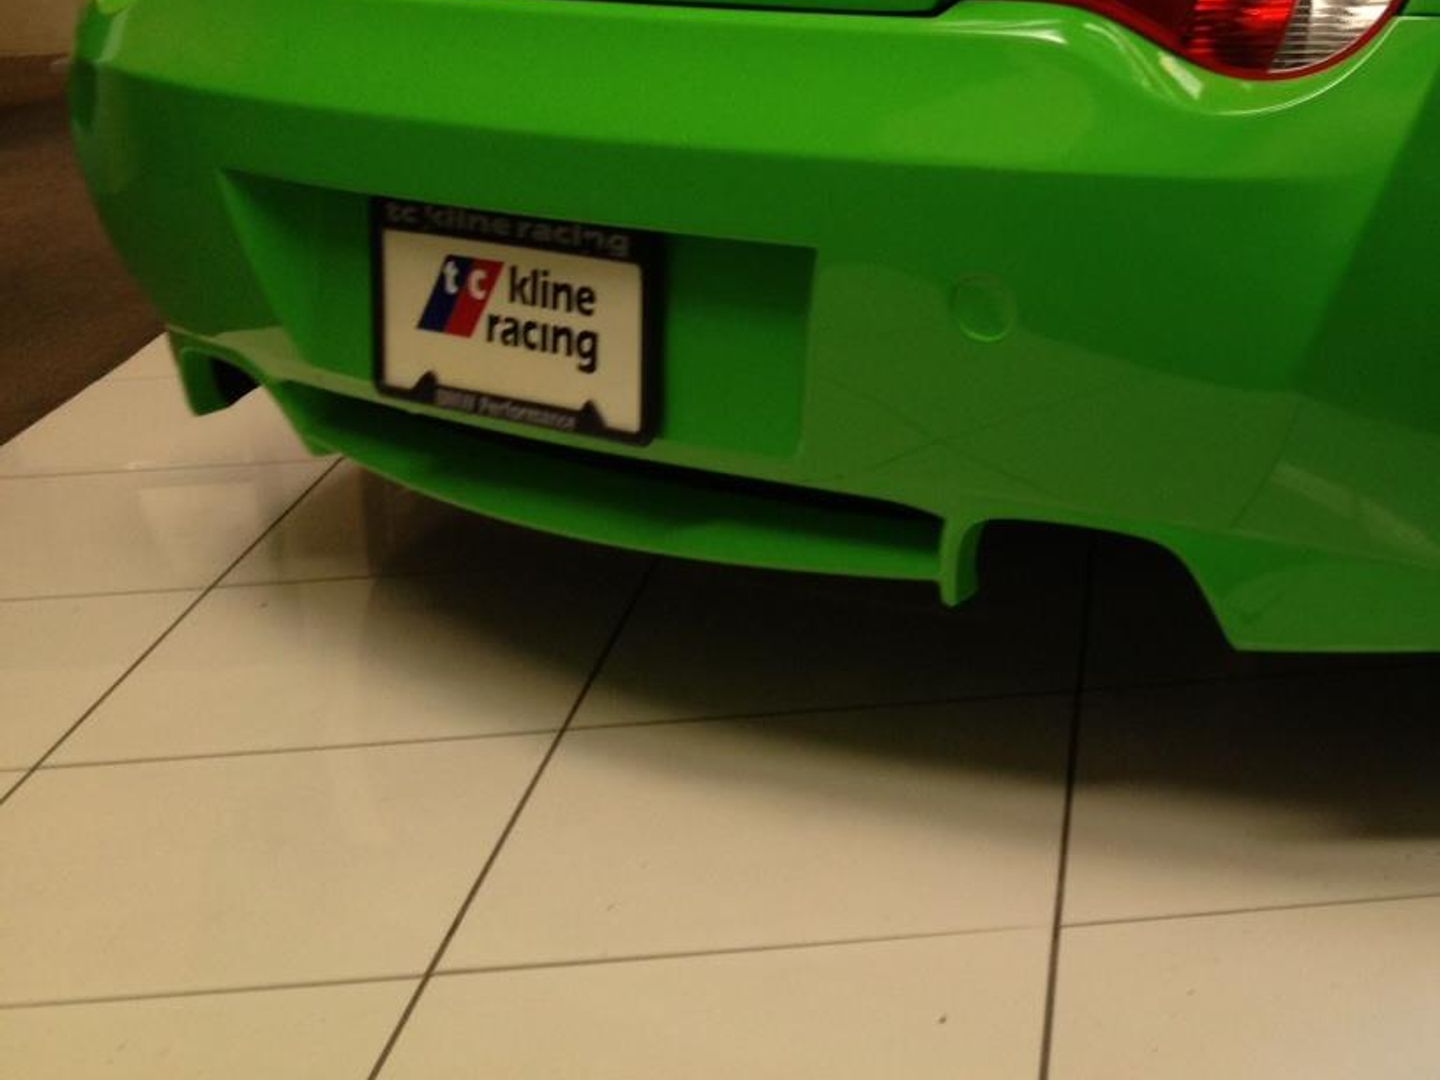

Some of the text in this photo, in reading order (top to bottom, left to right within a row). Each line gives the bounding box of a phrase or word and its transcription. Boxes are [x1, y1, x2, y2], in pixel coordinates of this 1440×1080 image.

[423, 205, 511, 237] kline
[515, 223, 631, 258] racing
[443, 261, 596, 316] tc kline
[486, 313, 598, 374] racing
